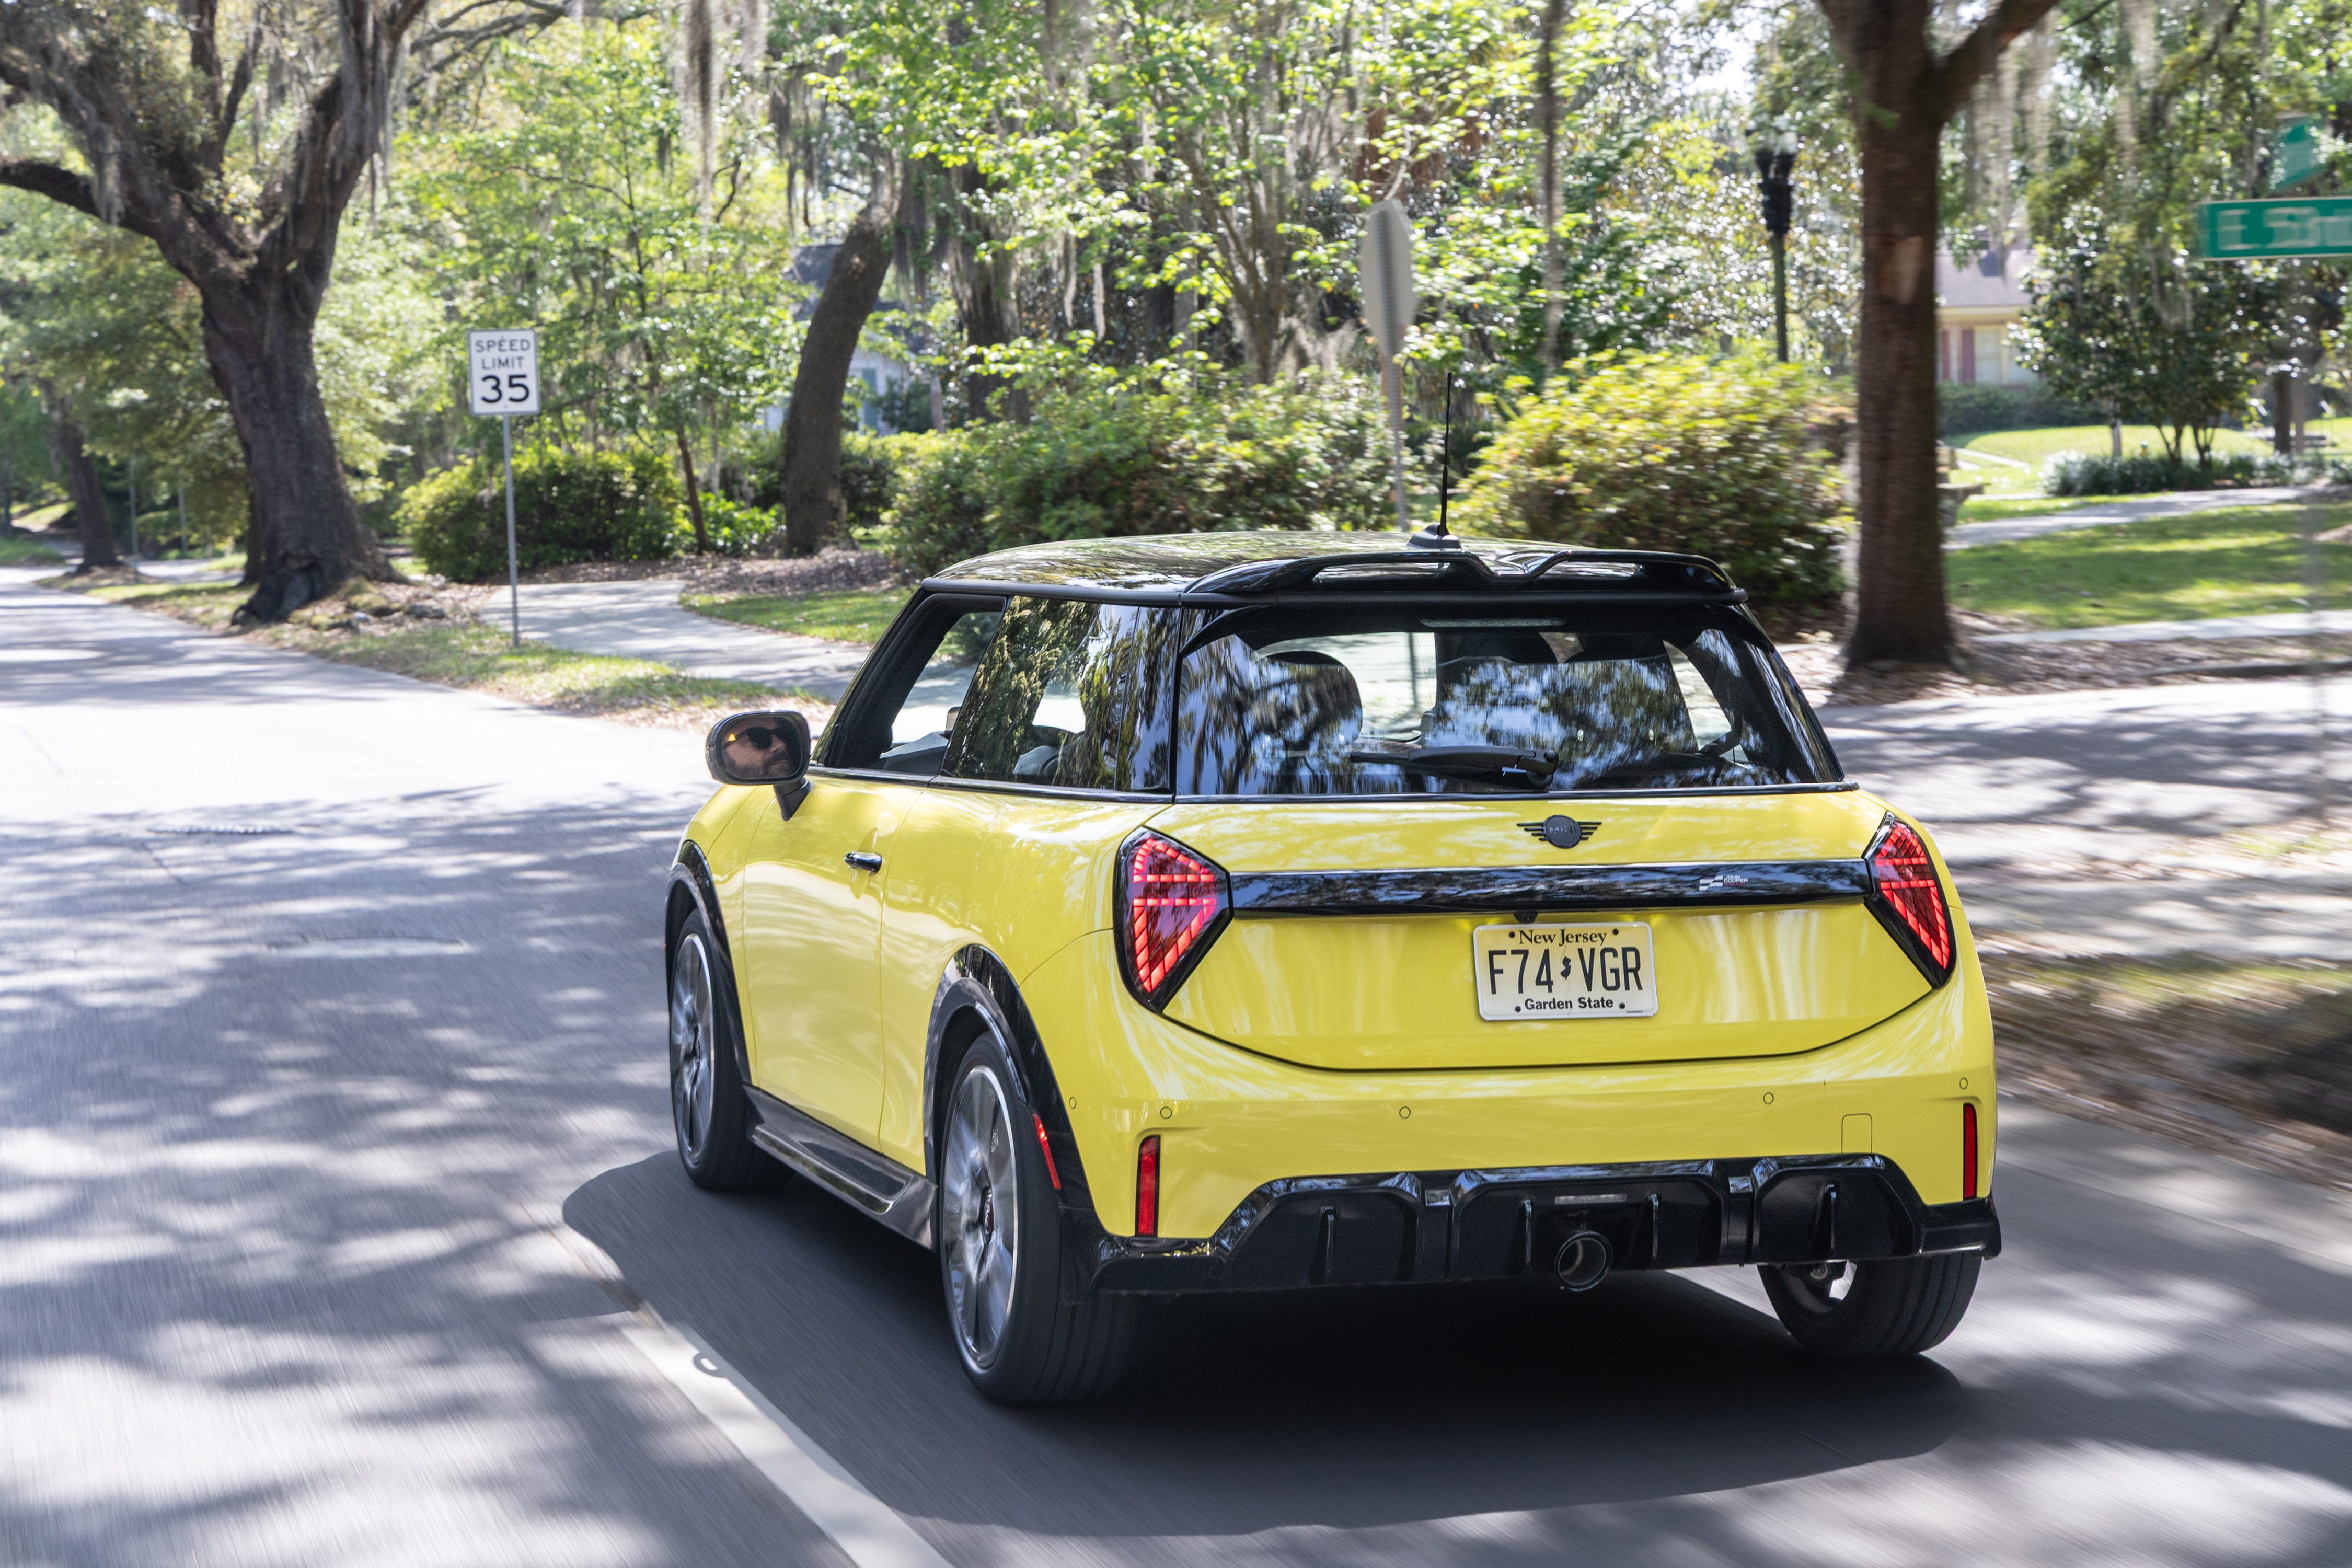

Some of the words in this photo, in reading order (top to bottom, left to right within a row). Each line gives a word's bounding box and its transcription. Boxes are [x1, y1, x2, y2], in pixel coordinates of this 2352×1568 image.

[475, 339, 531, 353] SPEED
[481, 356, 524, 370] LIMIT
[481, 374, 529, 403] 35
[1519, 929, 1556, 944] New
[1559, 928, 1607, 947] Jersey
[1488, 948, 1554, 995] F74
[1577, 946, 1643, 992] VGR
[1524, 998, 1573, 1011] Garden
[1577, 997, 1614, 1008] State
